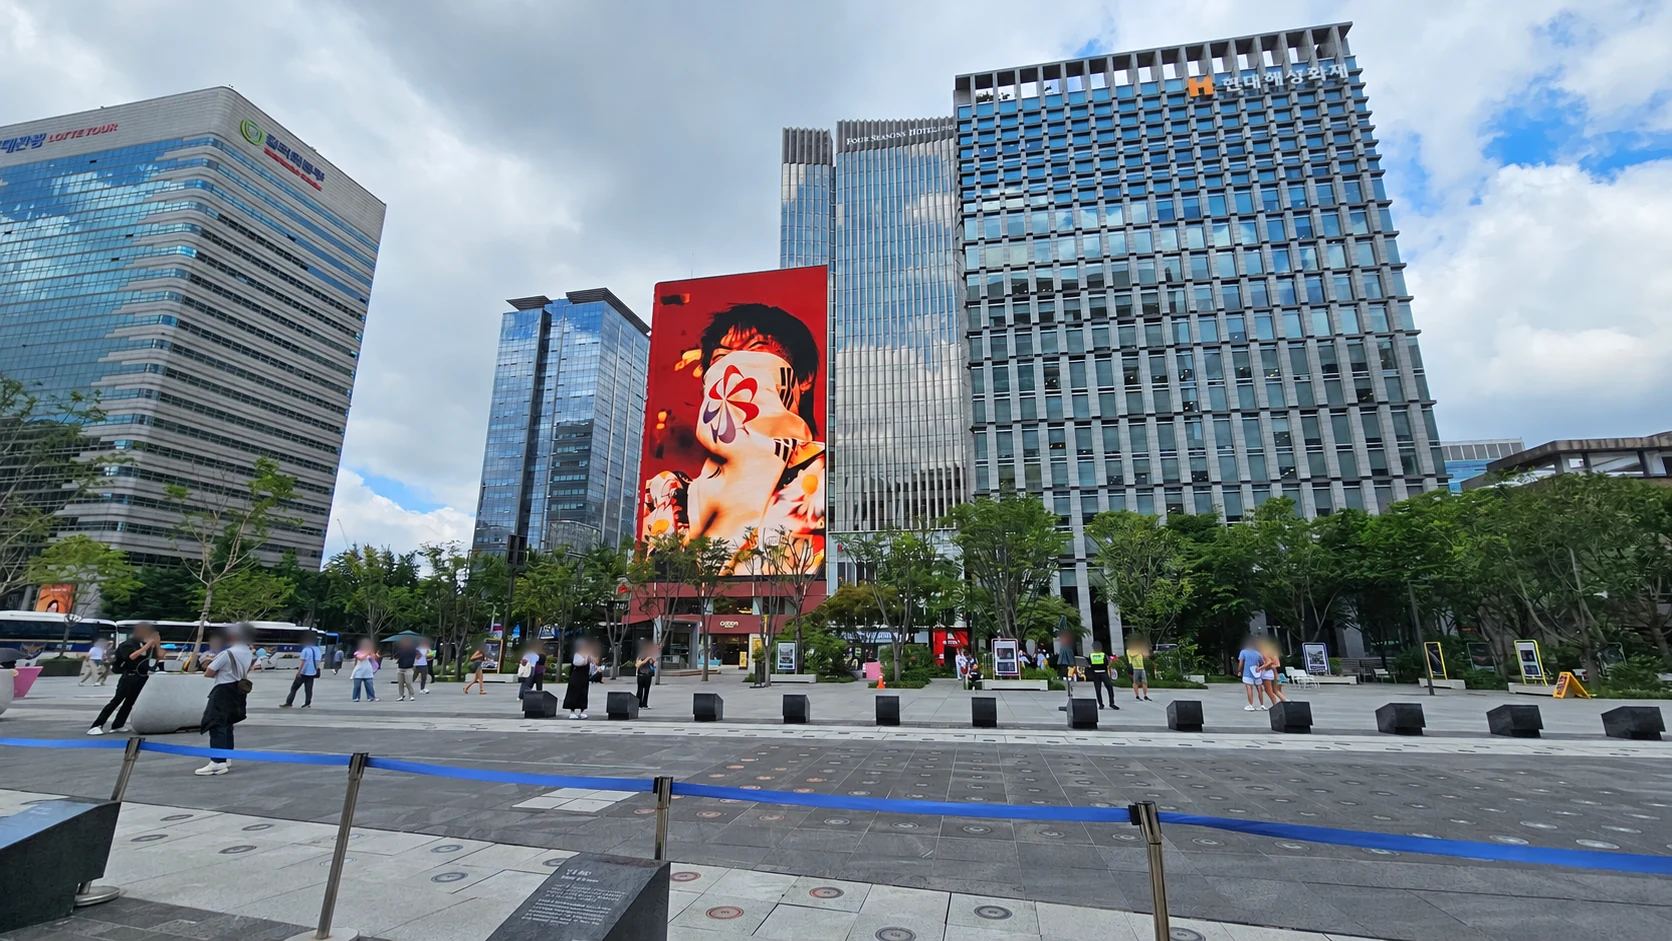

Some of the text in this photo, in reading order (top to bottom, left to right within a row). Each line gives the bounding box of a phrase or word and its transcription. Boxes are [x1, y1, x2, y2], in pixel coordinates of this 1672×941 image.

[1222, 63, 1349, 92] 현대해상화재
[0, 132, 47, 154] 데관광
[48, 123, 118, 143] LOTTE TOUR
